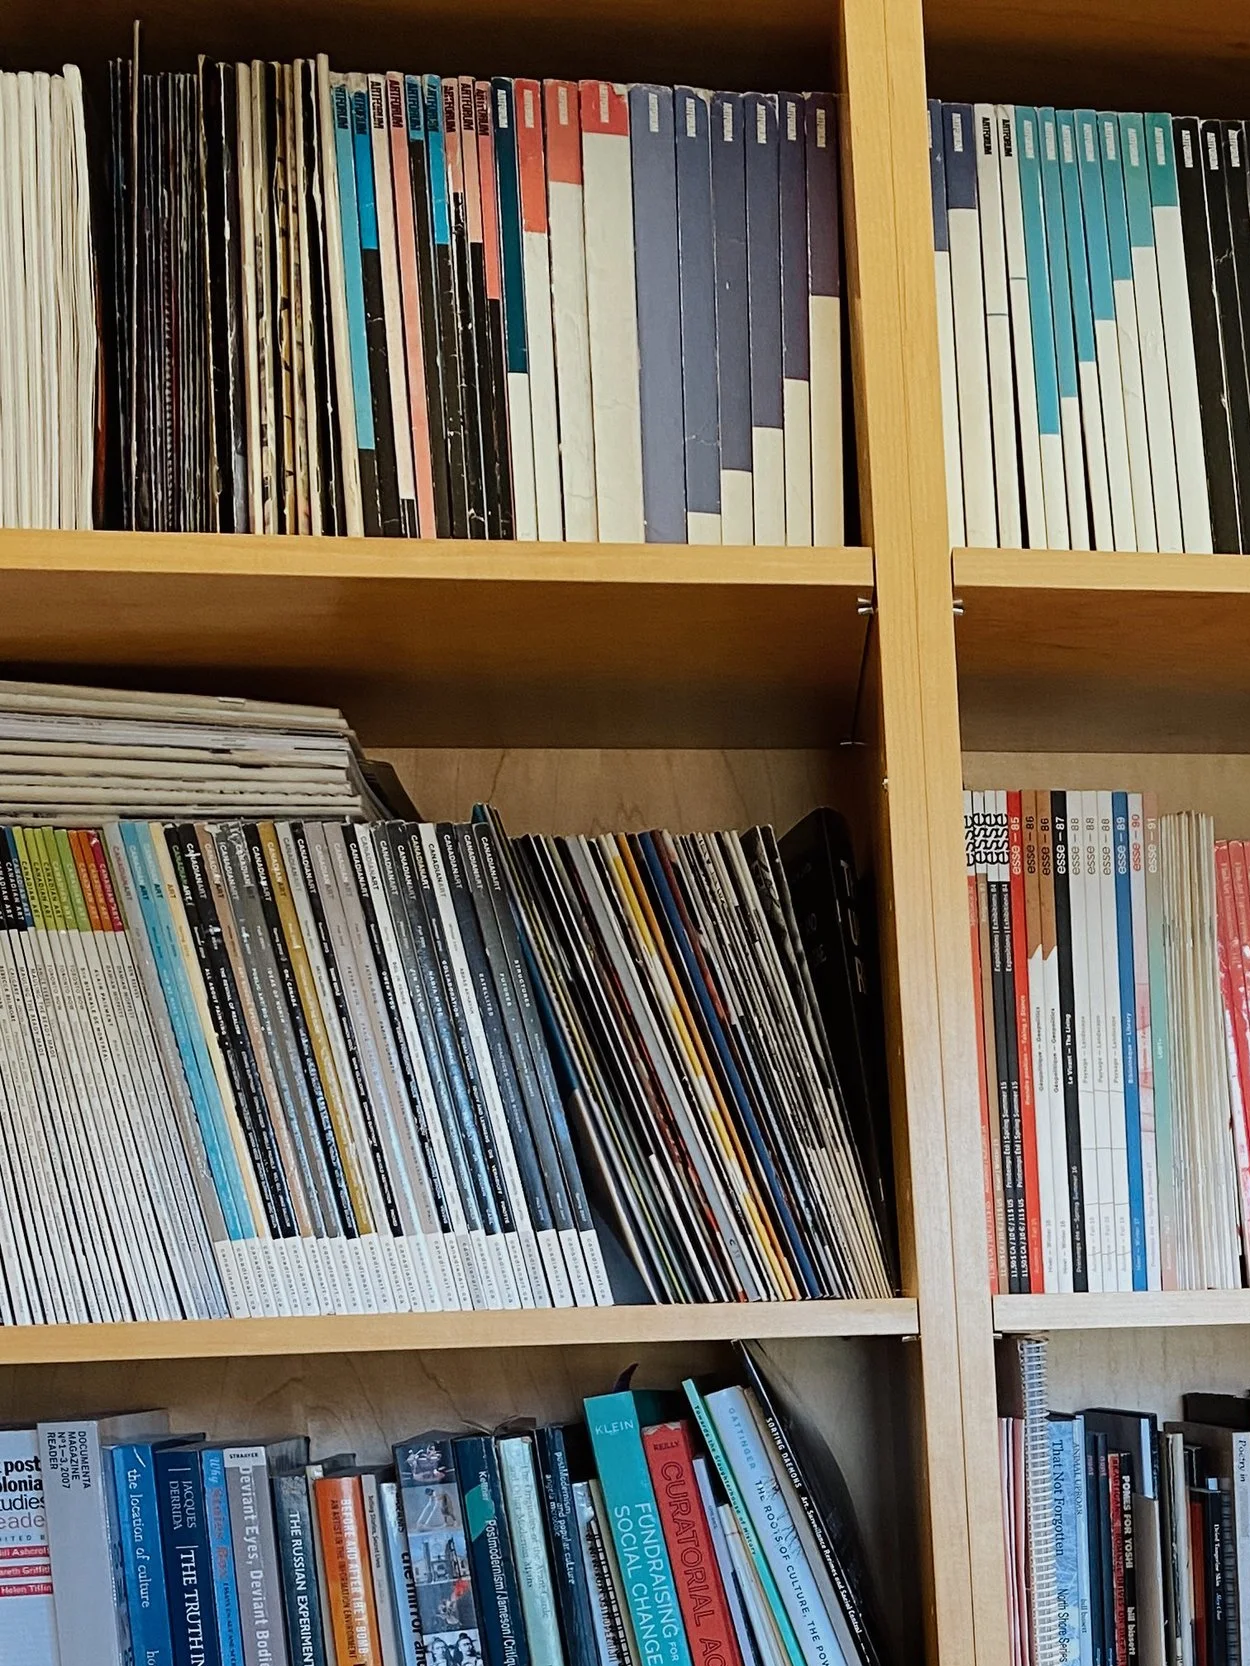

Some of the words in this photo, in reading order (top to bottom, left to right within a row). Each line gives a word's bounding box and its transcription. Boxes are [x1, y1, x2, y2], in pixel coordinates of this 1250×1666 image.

[1010, 817, 1020, 830] 85
[1025, 816, 1035, 830] 86
[1055, 816, 1065, 830] 87
[1116, 817, 1125, 830] 89
[1012, 845, 1021, 874] esse
[1027, 845, 1036, 874] esse
[1056, 845, 1066, 874] esse
[1117, 846, 1127, 874] esse
[22, 861, 35, 901] CANADIAN
[595, 1419, 634, 1436] KLEIN
[47, 1432, 59, 1470] READER
[68, 1431, 80, 1480] MAGAZINE
[78, 1431, 91, 1489] DOCUMENTA
[1052, 1439, 1064, 1467] That
[1054, 1471, 1065, 1493] Not
[1122, 1475, 1131, 1515] POMES
[169, 1481, 182, 1530] DERRIDA
[182, 1480, 197, 1529] JACQUES
[1055, 1499, 1065, 1557] Forgotten
[1123, 1517, 1132, 1534] FOR
[661, 1461, 714, 1627] CURATORIAL
[1124, 1536, 1133, 1569] YOSHI
[181, 1551, 195, 1586] THE
[614, 1505, 637, 1578] SOCIAL
[632, 1583, 664, 1666] CHANGE
[635, 1503, 679, 1638] FUNDRAISING
[670, 1642, 679, 1661] FOR
[184, 1593, 204, 1650] TRUTH
